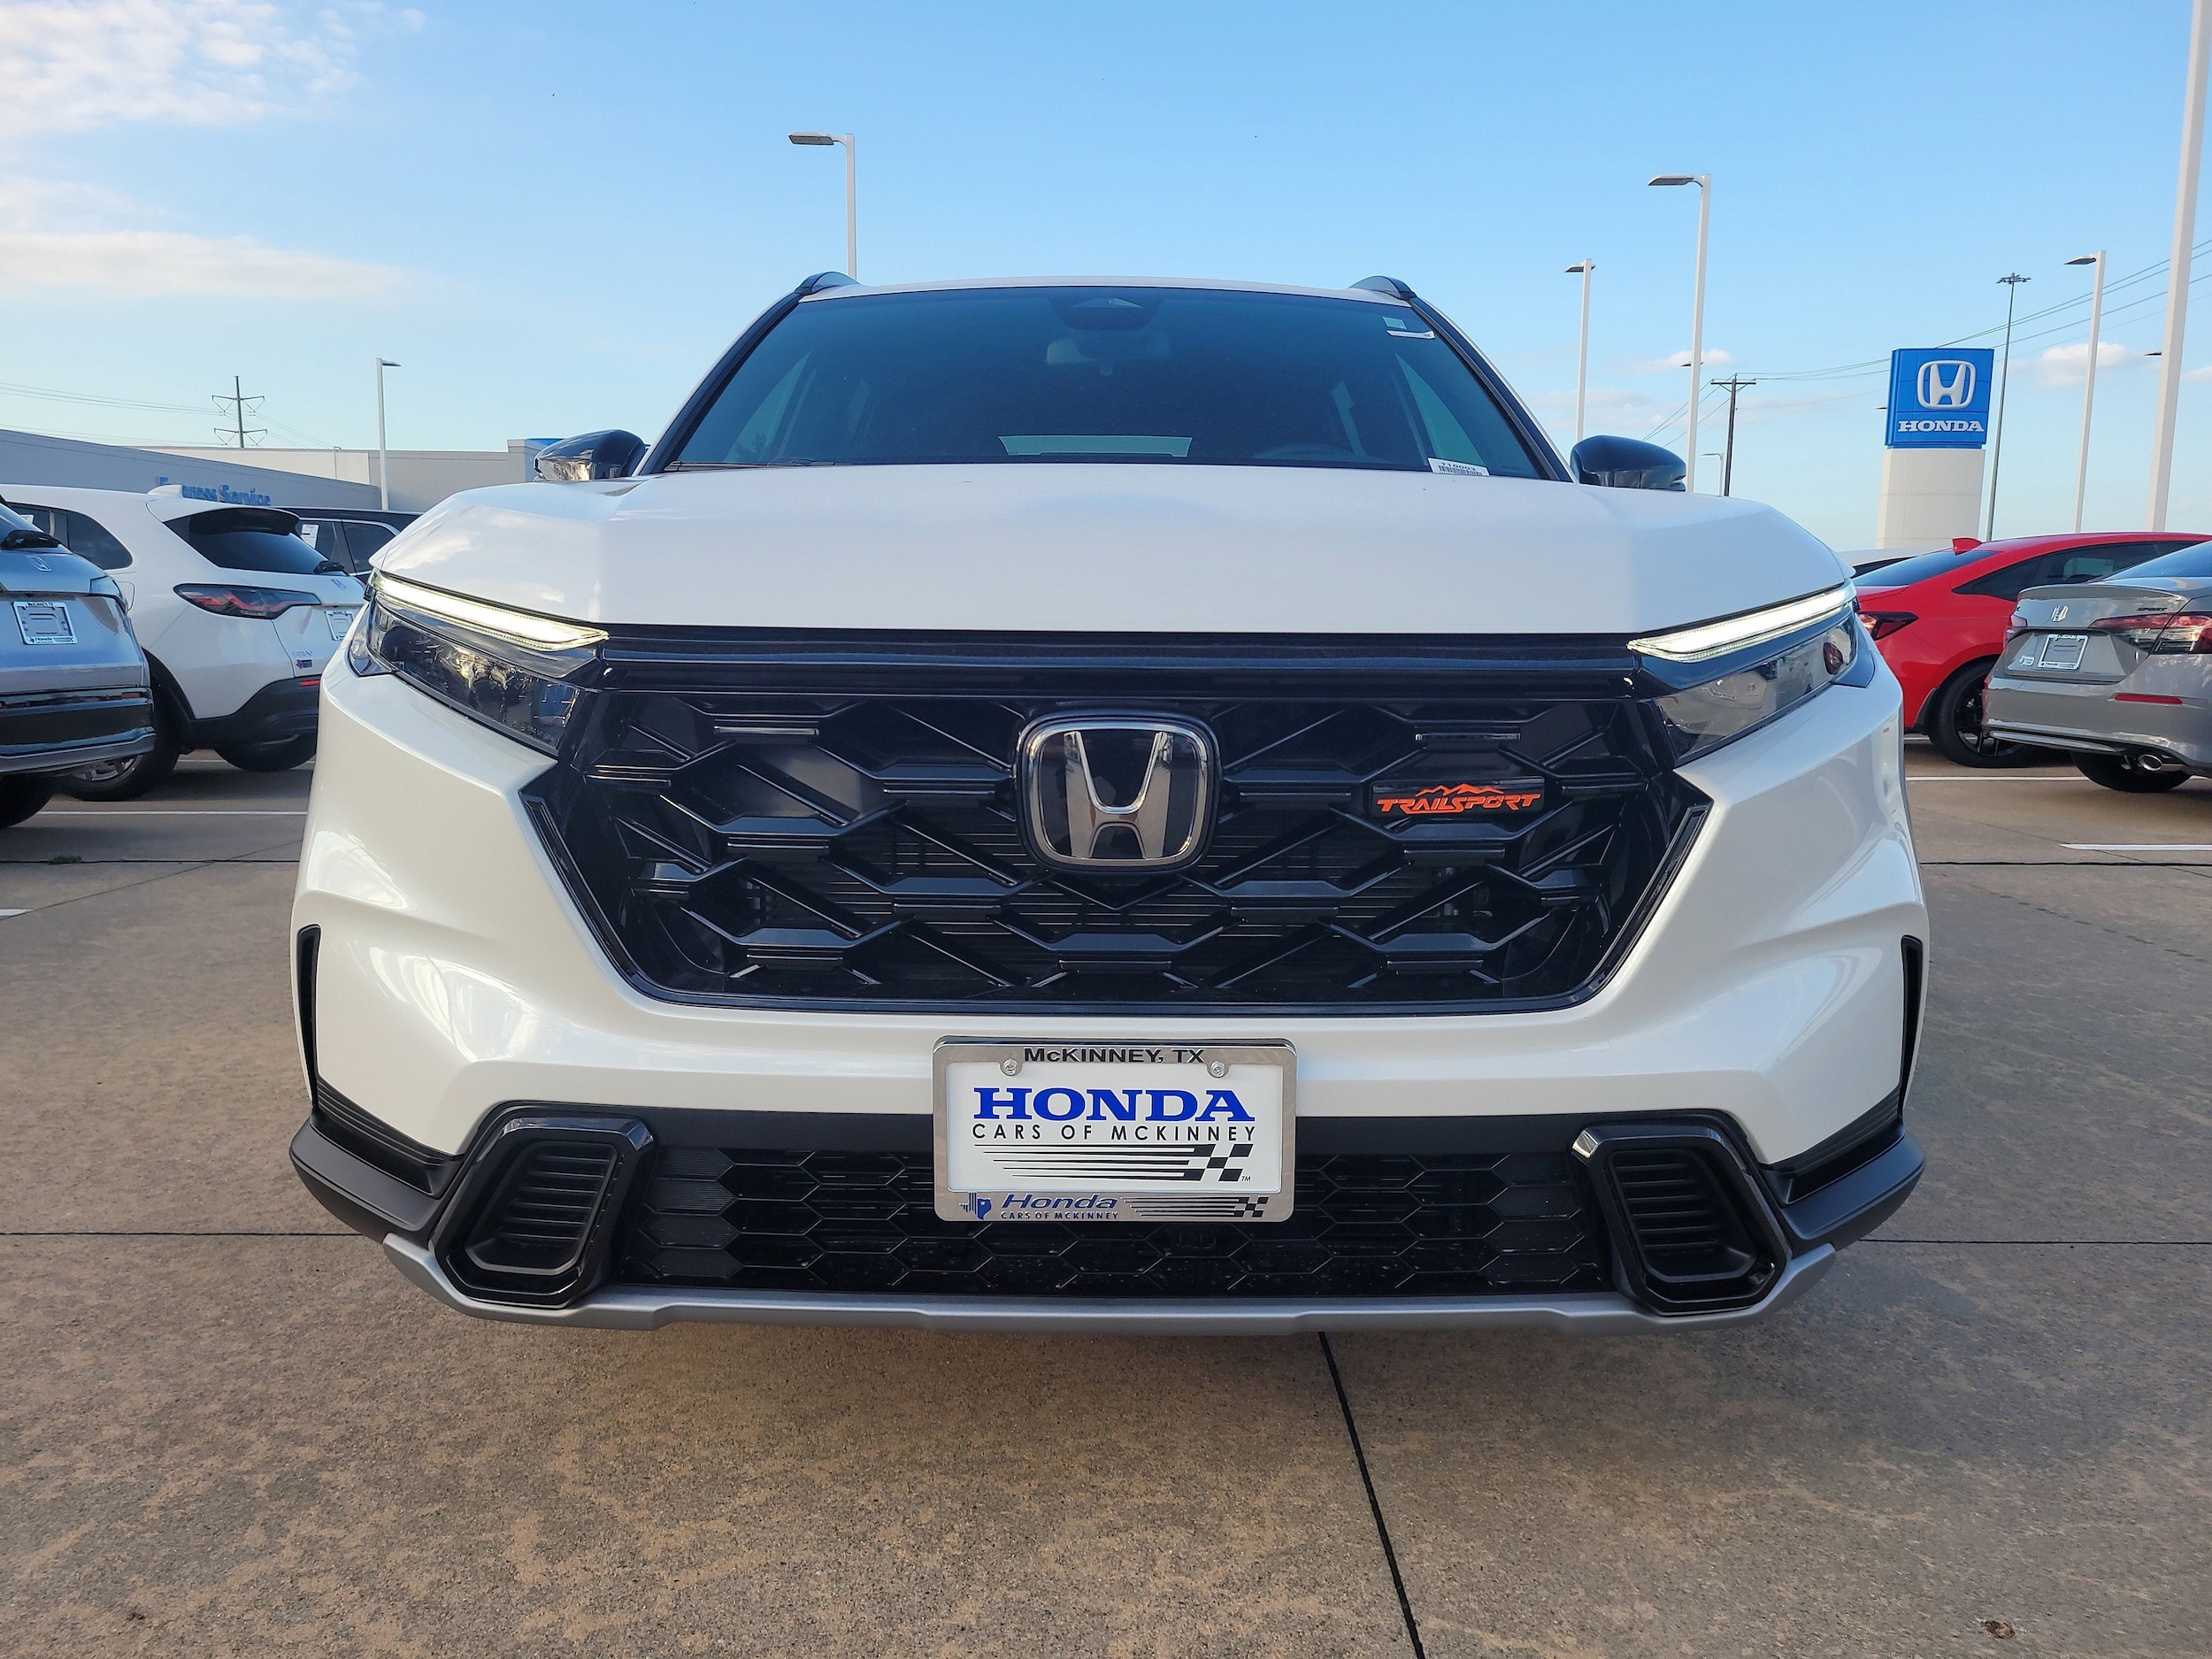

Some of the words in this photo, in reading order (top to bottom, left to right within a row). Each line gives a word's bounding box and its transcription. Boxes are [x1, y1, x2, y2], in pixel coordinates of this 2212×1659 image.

[1897, 420, 1985, 433] HONDA
[1377, 794, 1541, 815] TRAILSPORT
[1171, 1048, 1206, 1064] TX
[973, 1087, 1256, 1122] HONDA
[972, 1123, 1041, 1140] CARS
[1060, 1124, 1094, 1141] OF
[1111, 1125, 1256, 1141] MCKINNEY
[1001, 1193, 1118, 1209] Honda
[1001, 1210, 1031, 1219] CARS
[1035, 1210, 1050, 1219] OF
[1055, 1210, 1118, 1220] MCKINNEY
